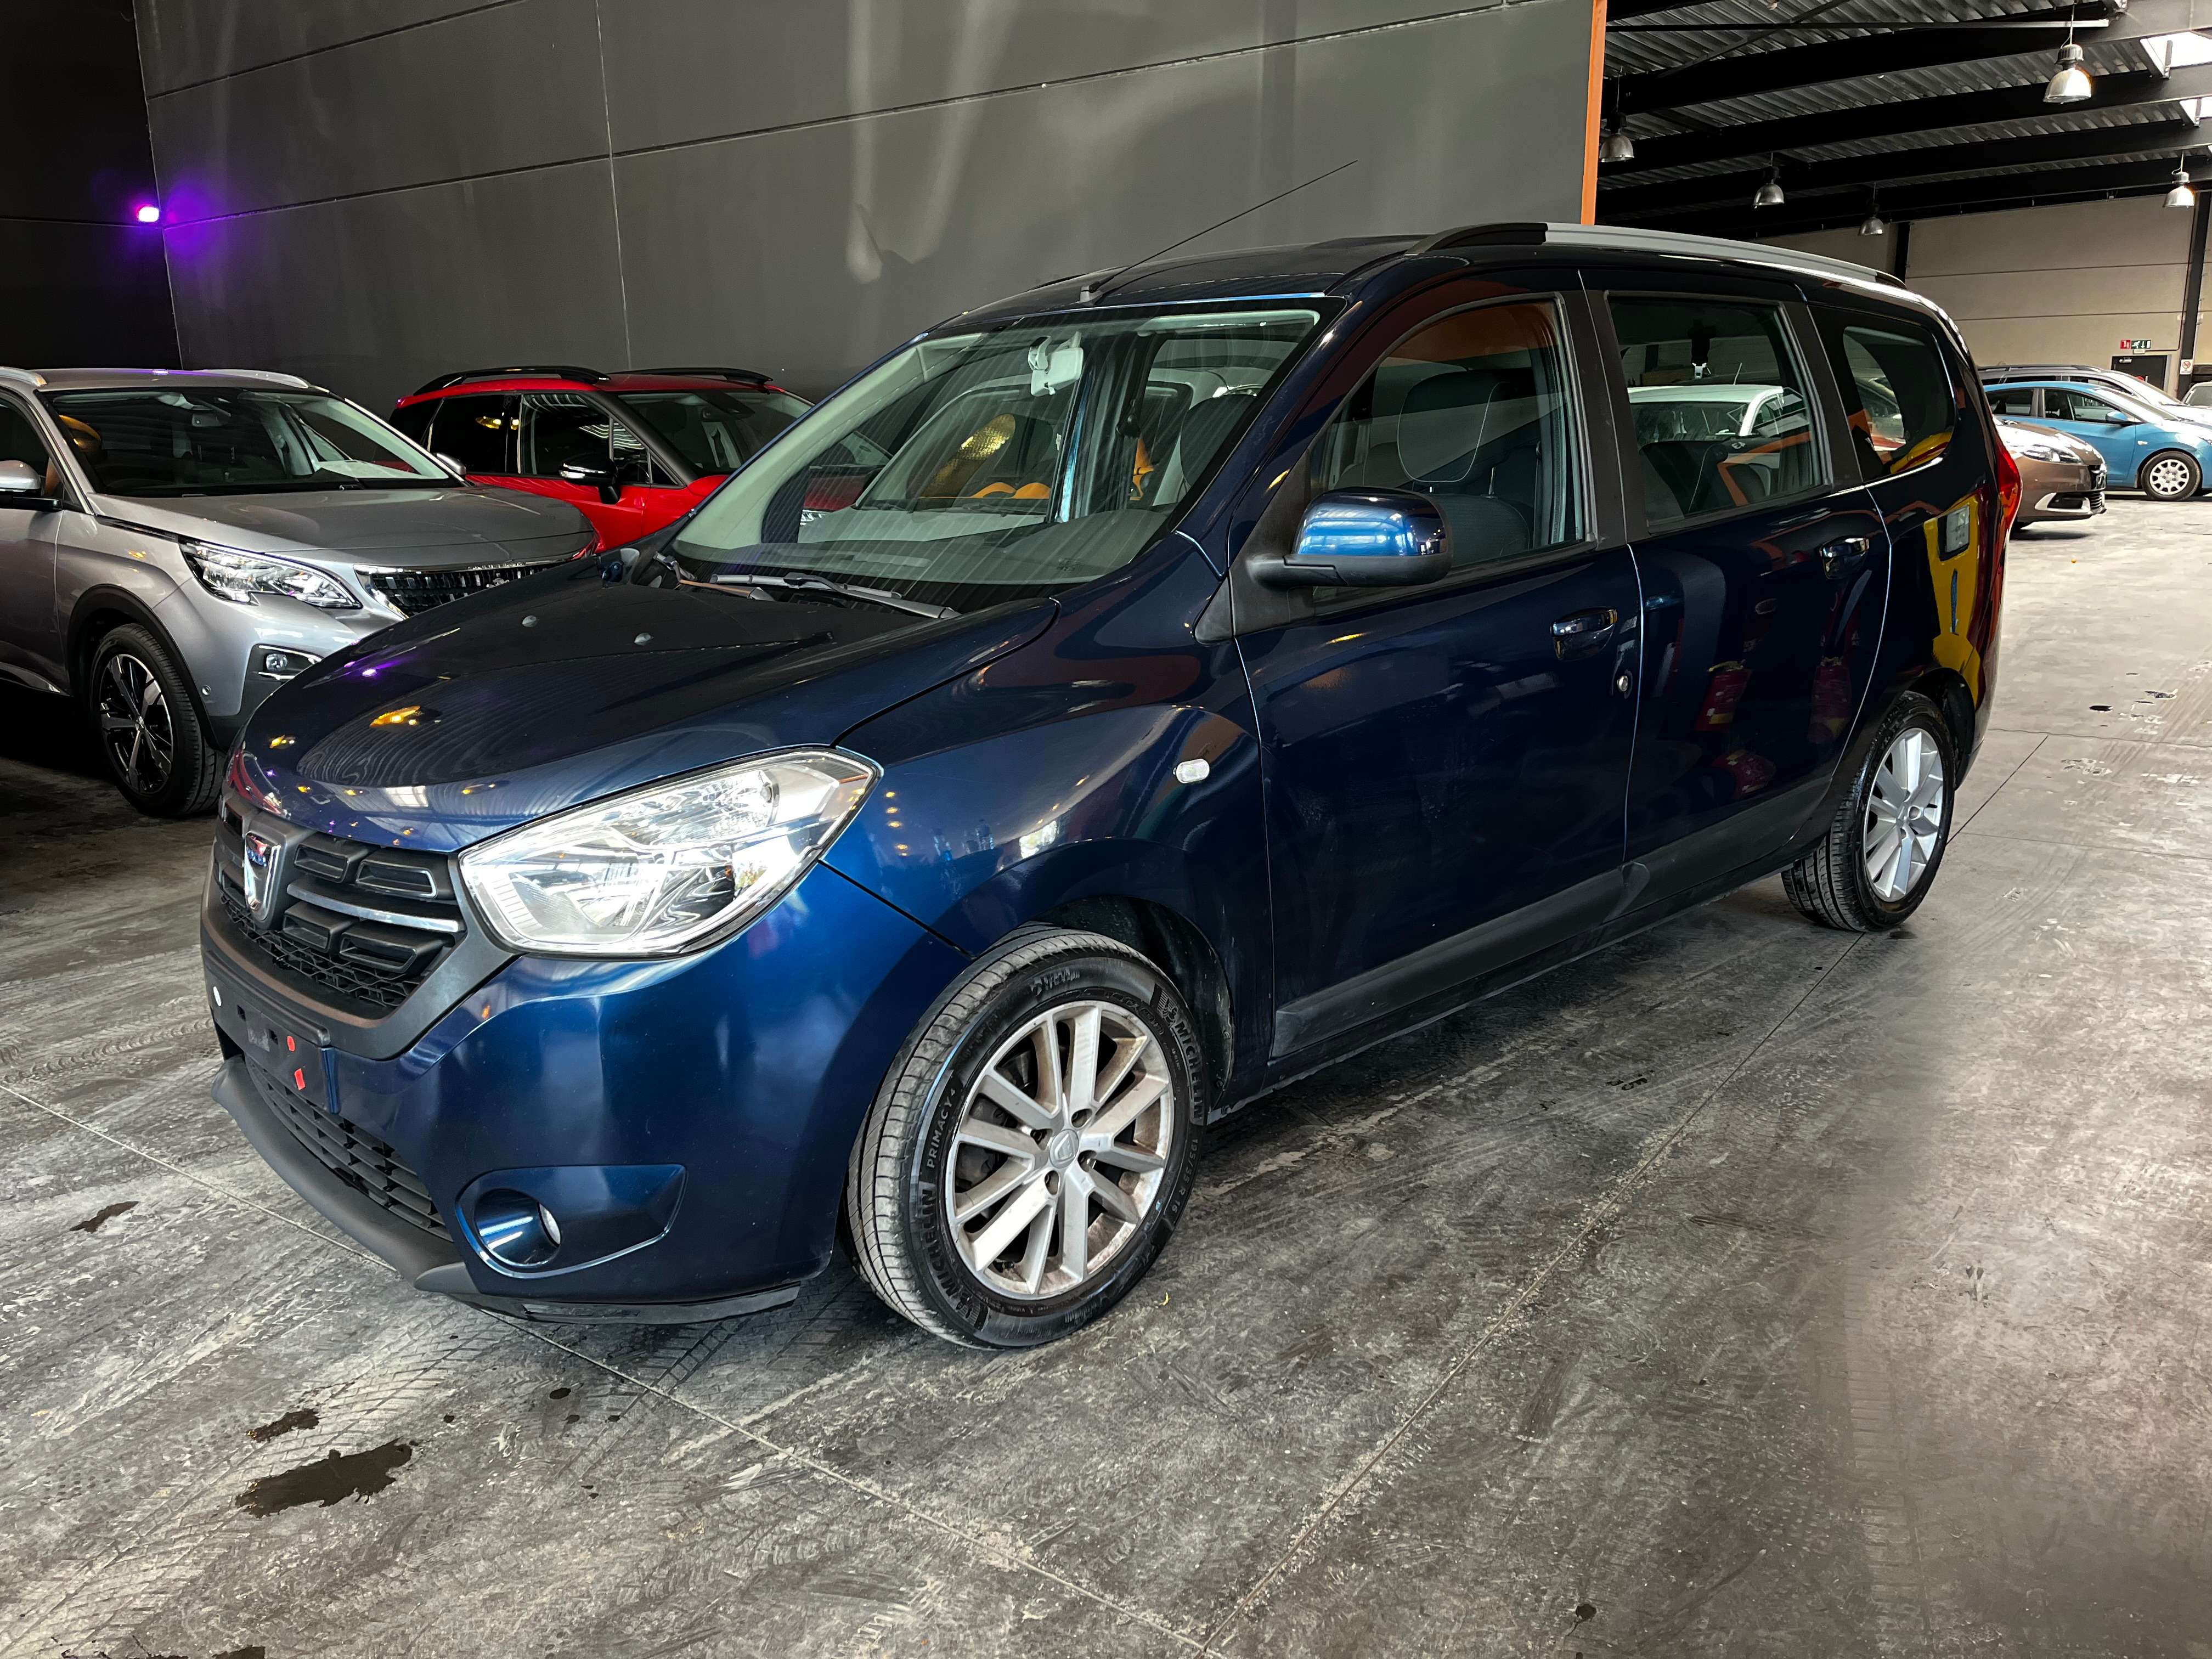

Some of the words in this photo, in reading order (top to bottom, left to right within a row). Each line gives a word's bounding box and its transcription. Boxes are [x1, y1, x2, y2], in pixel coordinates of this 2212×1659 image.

[1175, 1021, 1203, 1120] MICHELIN
[926, 1096, 952, 1169] PRIMACY
[951, 1088, 956, 1096] 4
[1172, 1200, 1180, 1213] 16
[1178, 1188, 1187, 1196] R
[921, 1189, 958, 1297] MICHELIN
